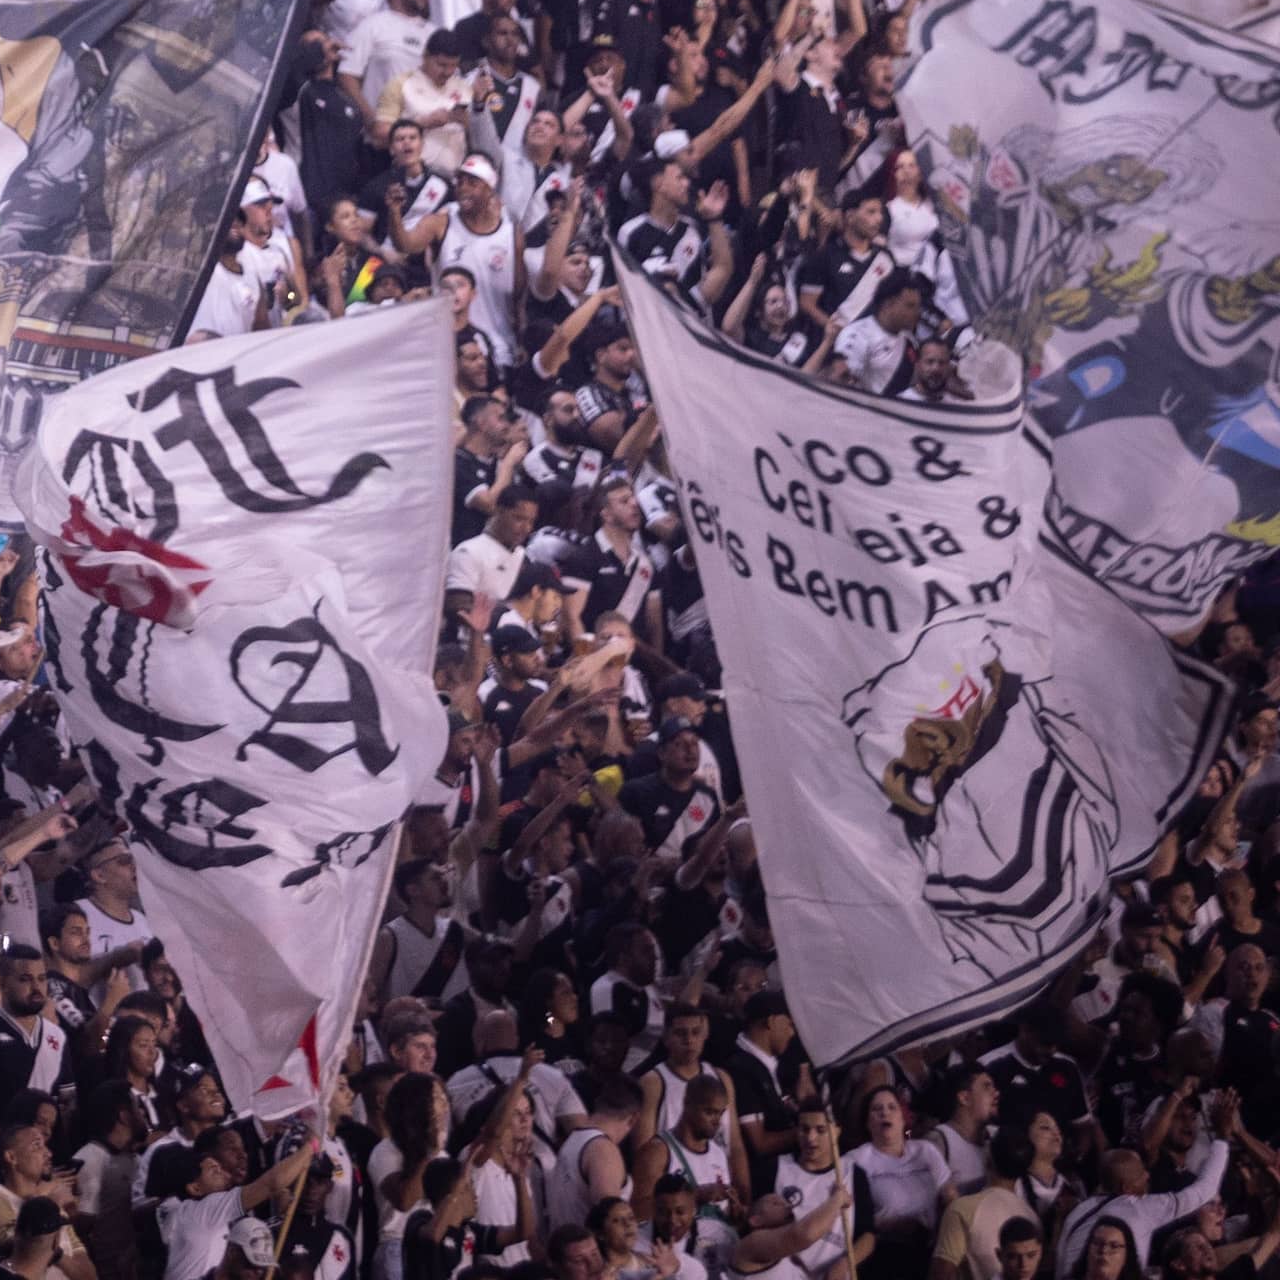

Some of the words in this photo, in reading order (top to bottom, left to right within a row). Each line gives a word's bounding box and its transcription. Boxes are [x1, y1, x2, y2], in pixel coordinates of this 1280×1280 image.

[913, 433, 971, 482] &
[978, 493, 1022, 540] &
[766, 532, 900, 634] Bem
